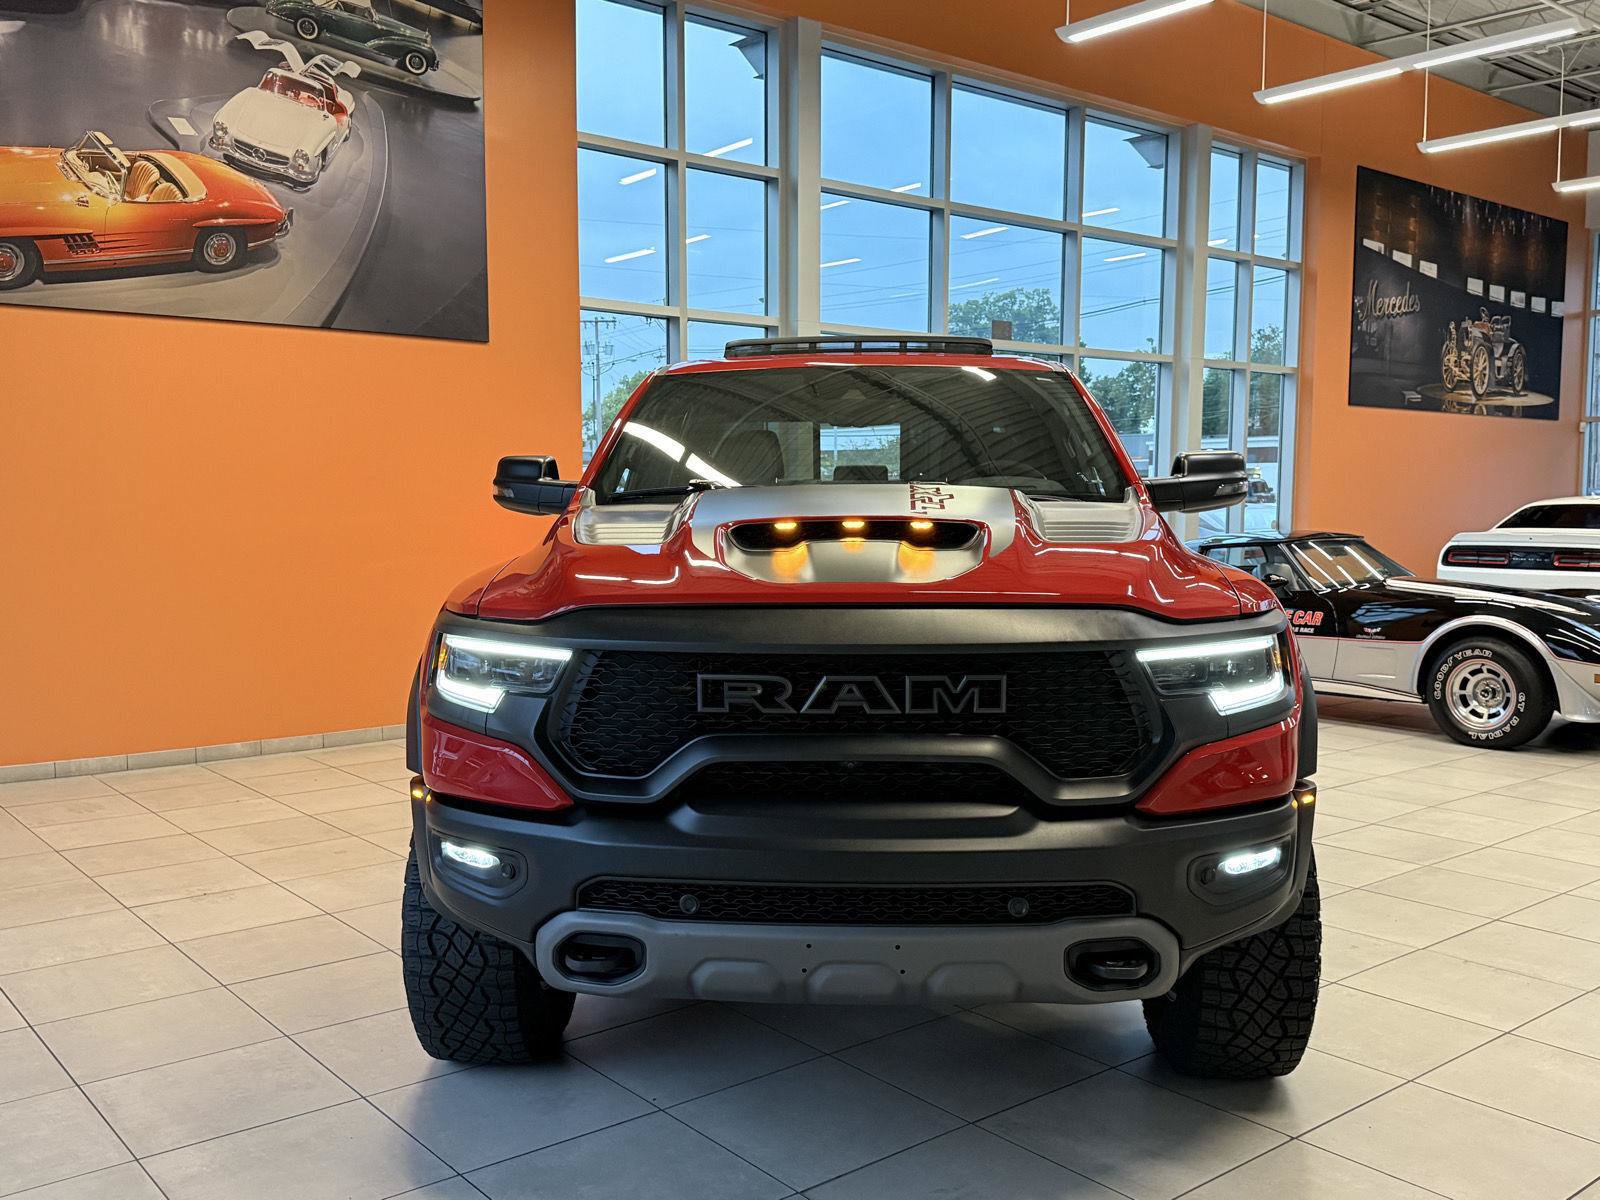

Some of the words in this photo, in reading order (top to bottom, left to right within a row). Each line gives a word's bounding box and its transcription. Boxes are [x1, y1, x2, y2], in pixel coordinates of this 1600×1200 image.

[1359, 280, 1420, 320] Mercedes
[1293, 610, 1324, 626] CAR
[1433, 648, 1493, 700] GOODYEAR
[697, 673, 1008, 714] RAM
[1518, 692, 1526, 712] GT
[1468, 715, 1520, 740] RADIAL
